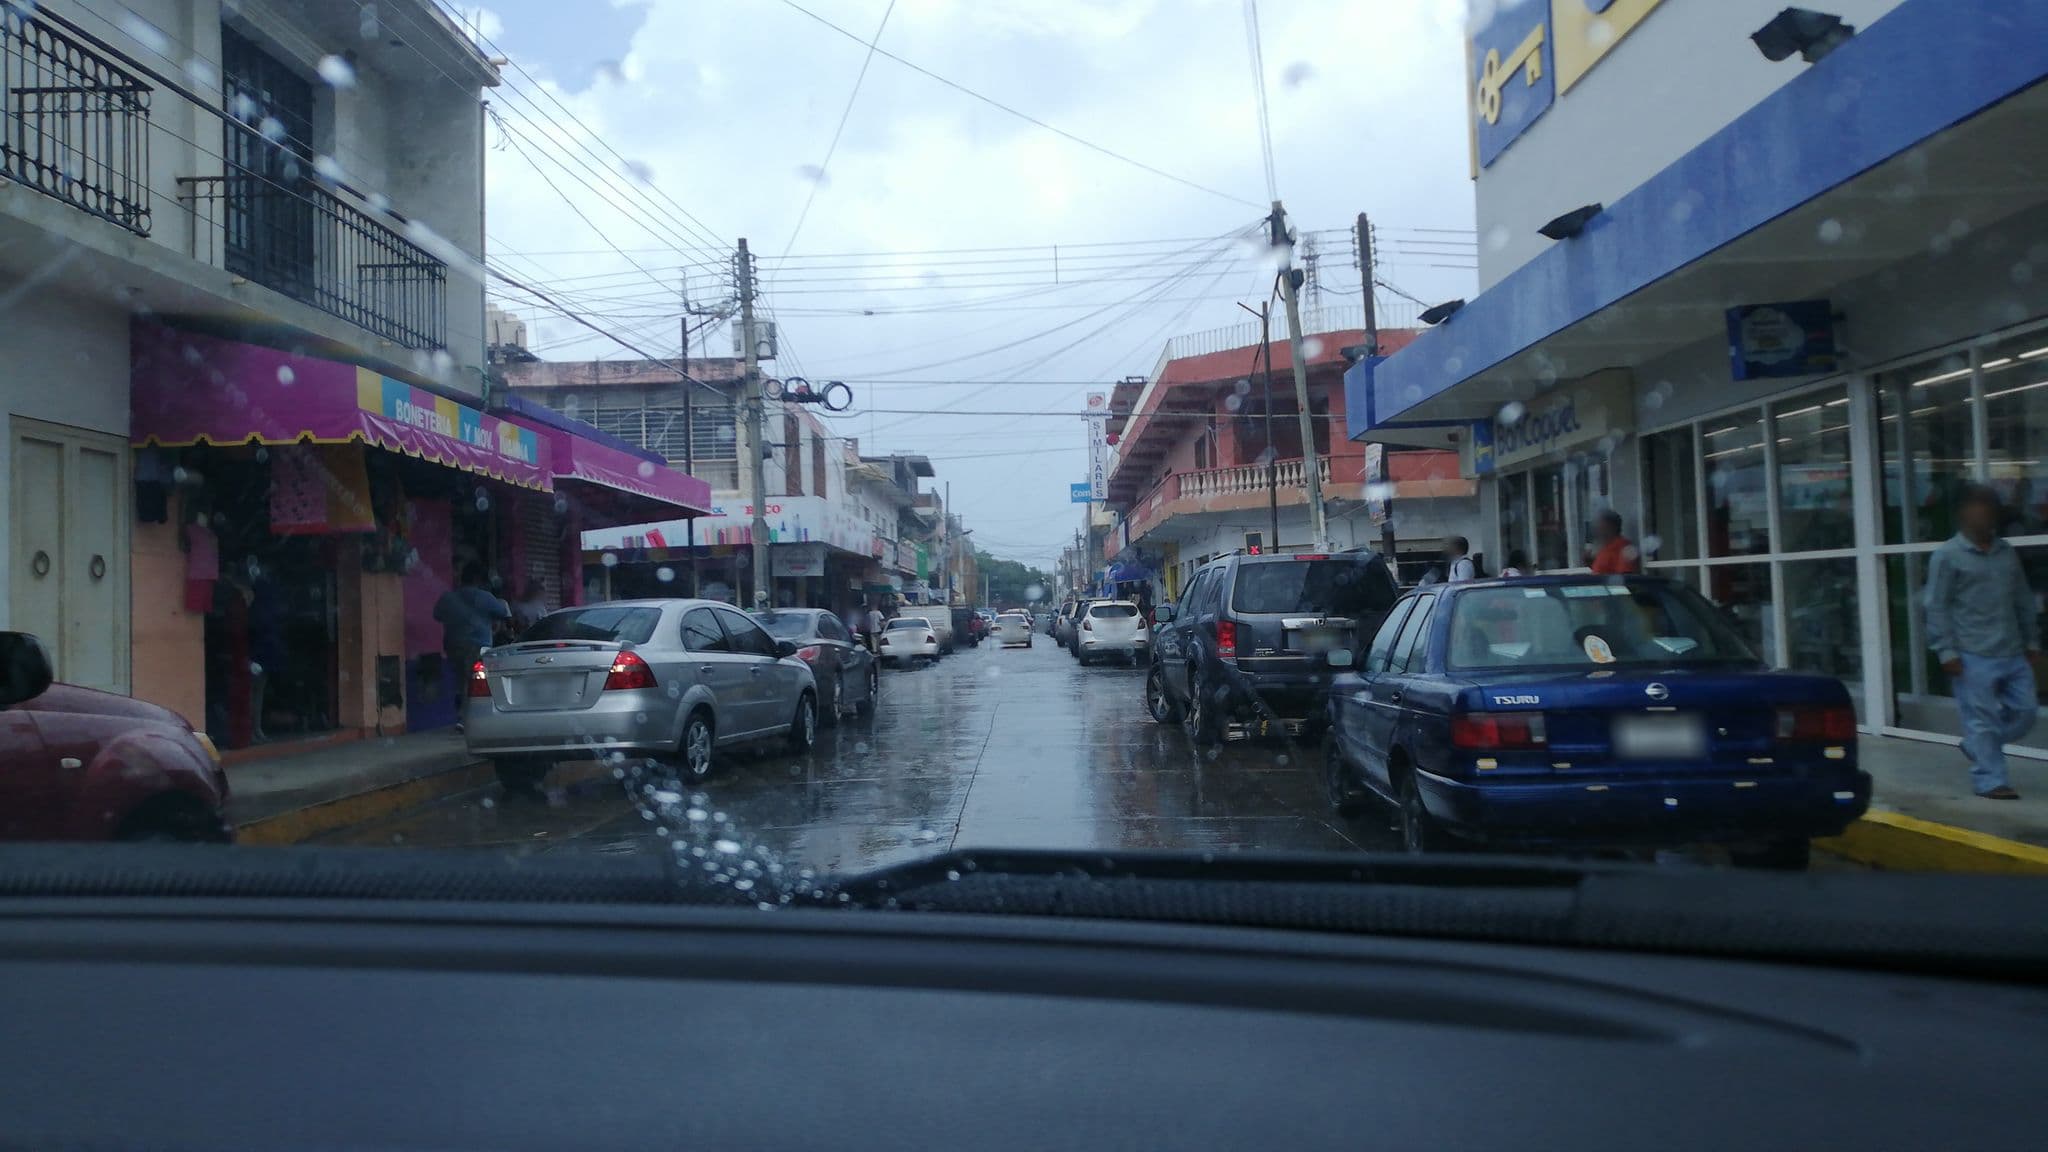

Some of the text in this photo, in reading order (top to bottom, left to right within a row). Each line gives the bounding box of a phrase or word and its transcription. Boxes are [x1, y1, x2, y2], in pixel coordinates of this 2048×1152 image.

[395, 399, 452, 436] BONETERIA
[464, 422, 471, 443] Y
[1093, 421, 1103, 498] SIMILARES
[1493, 695, 1540, 705] TSURU
